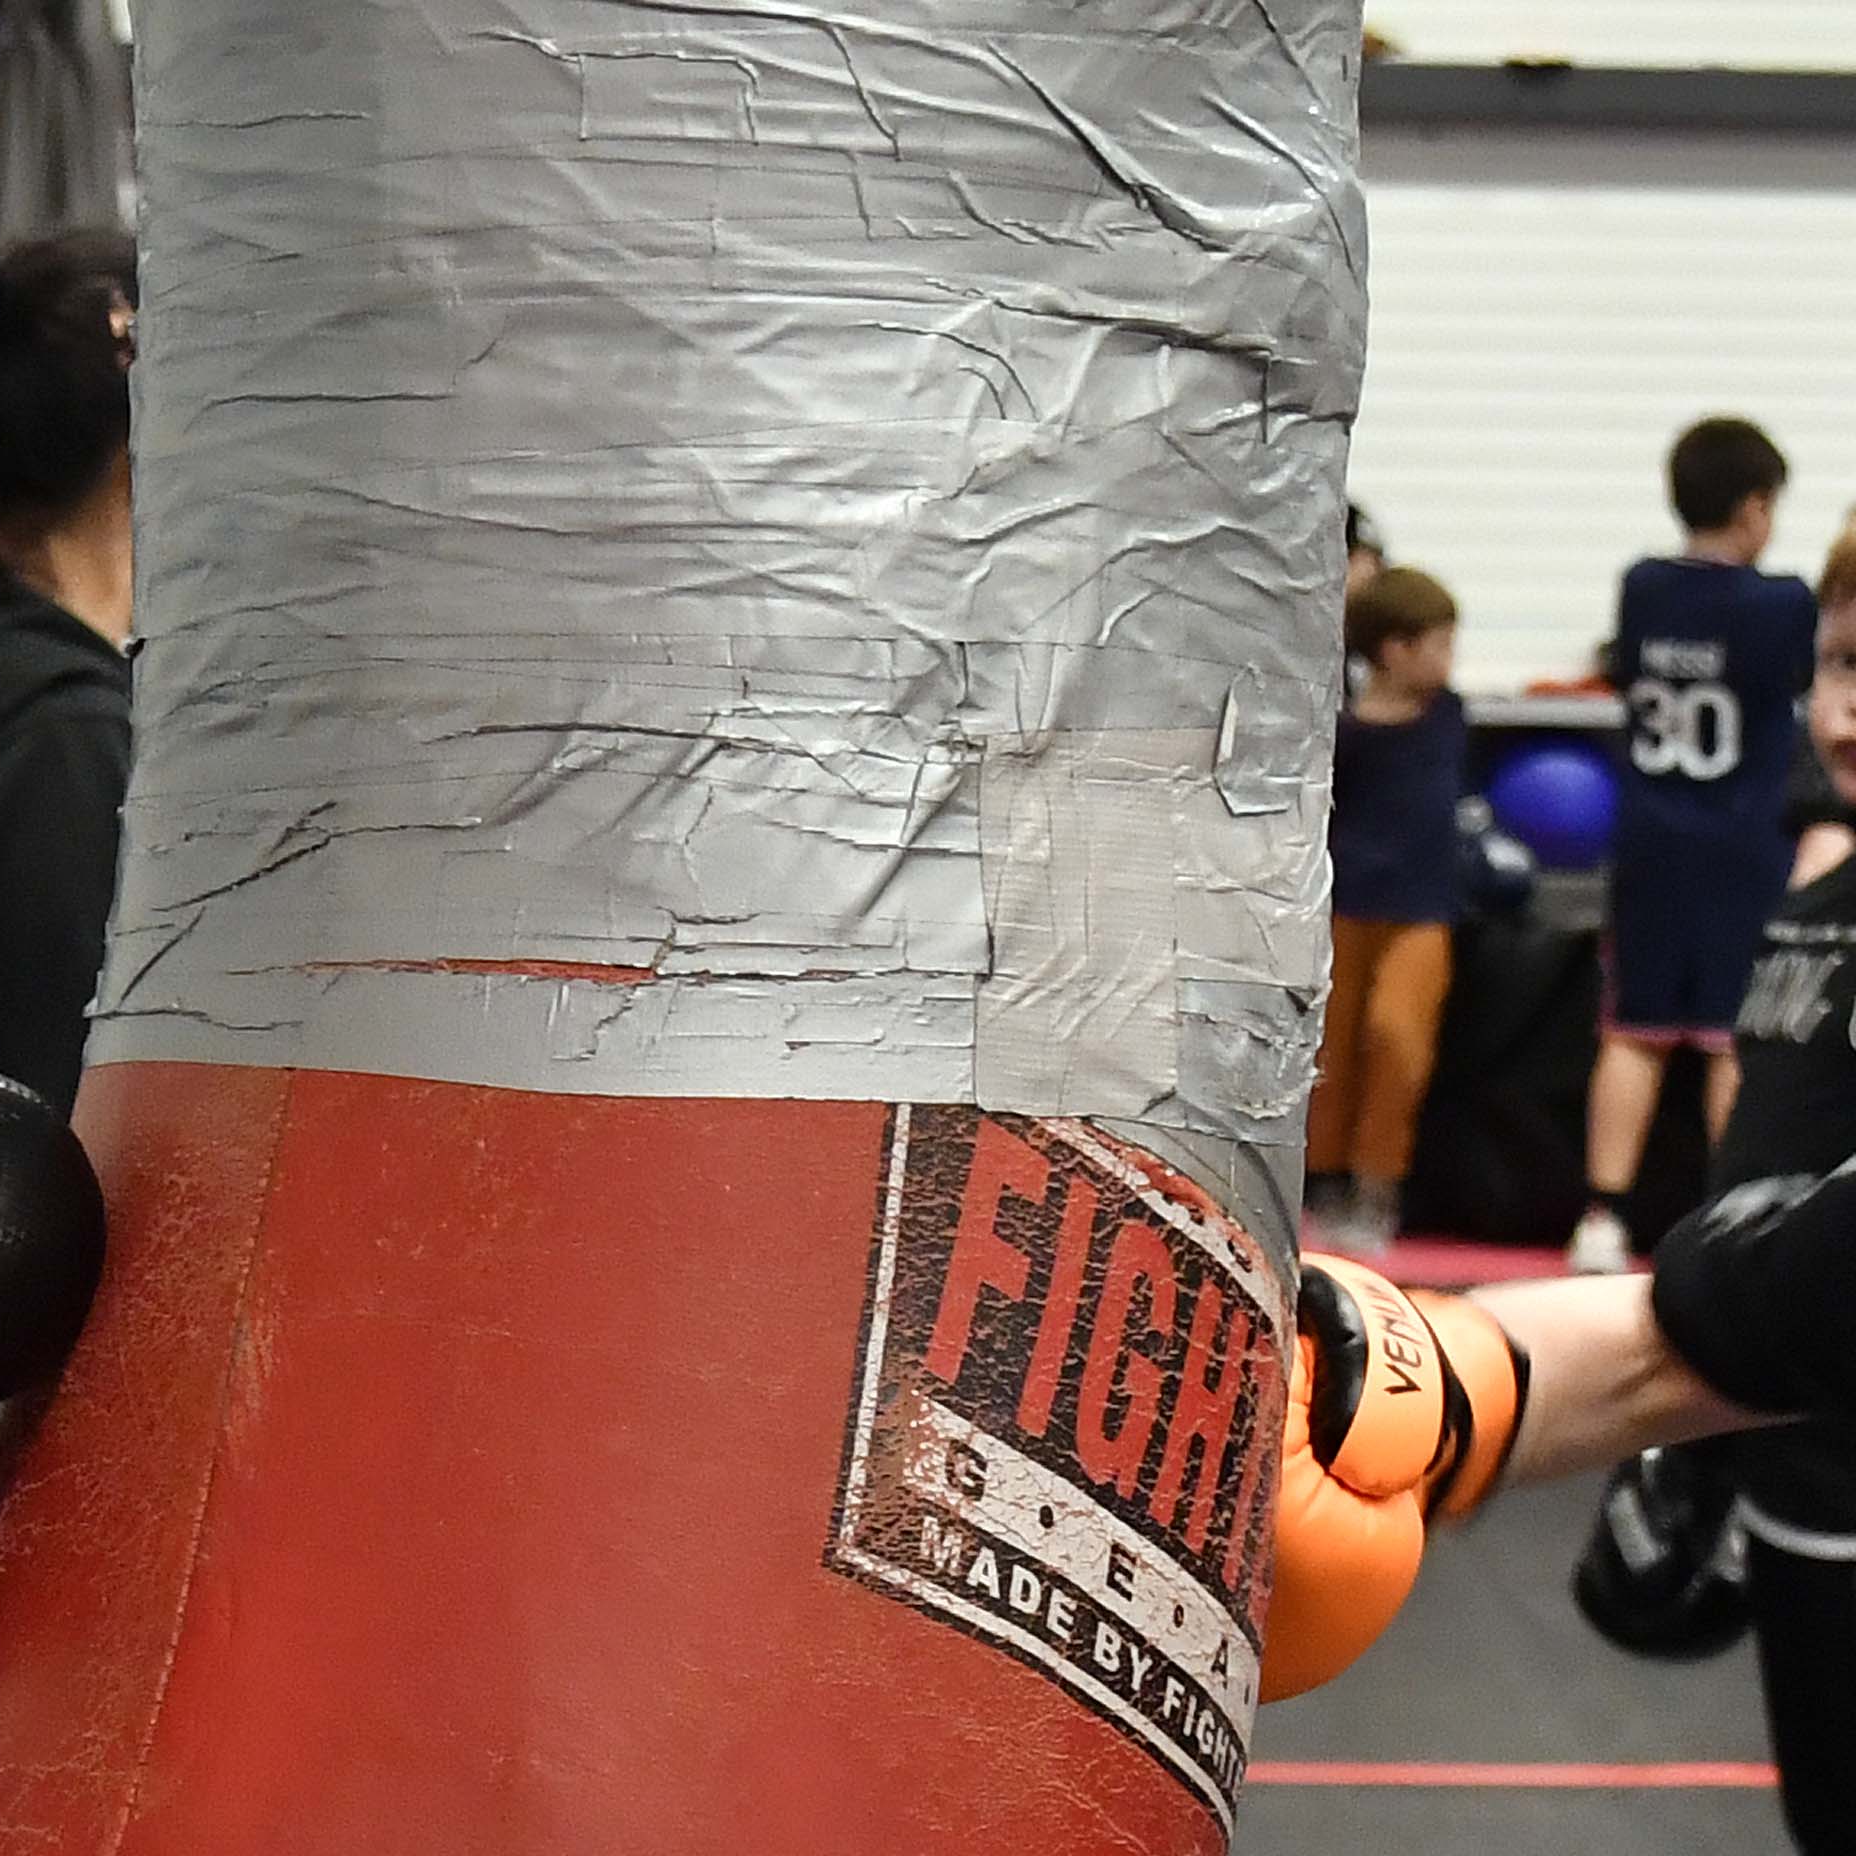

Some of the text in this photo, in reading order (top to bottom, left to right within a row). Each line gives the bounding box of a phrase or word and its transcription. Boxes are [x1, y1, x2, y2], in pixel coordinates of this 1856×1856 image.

[1629, 678, 1743, 782] 30
[919, 1515, 1078, 1641] MADE
[1092, 1620, 1153, 1693] BY
